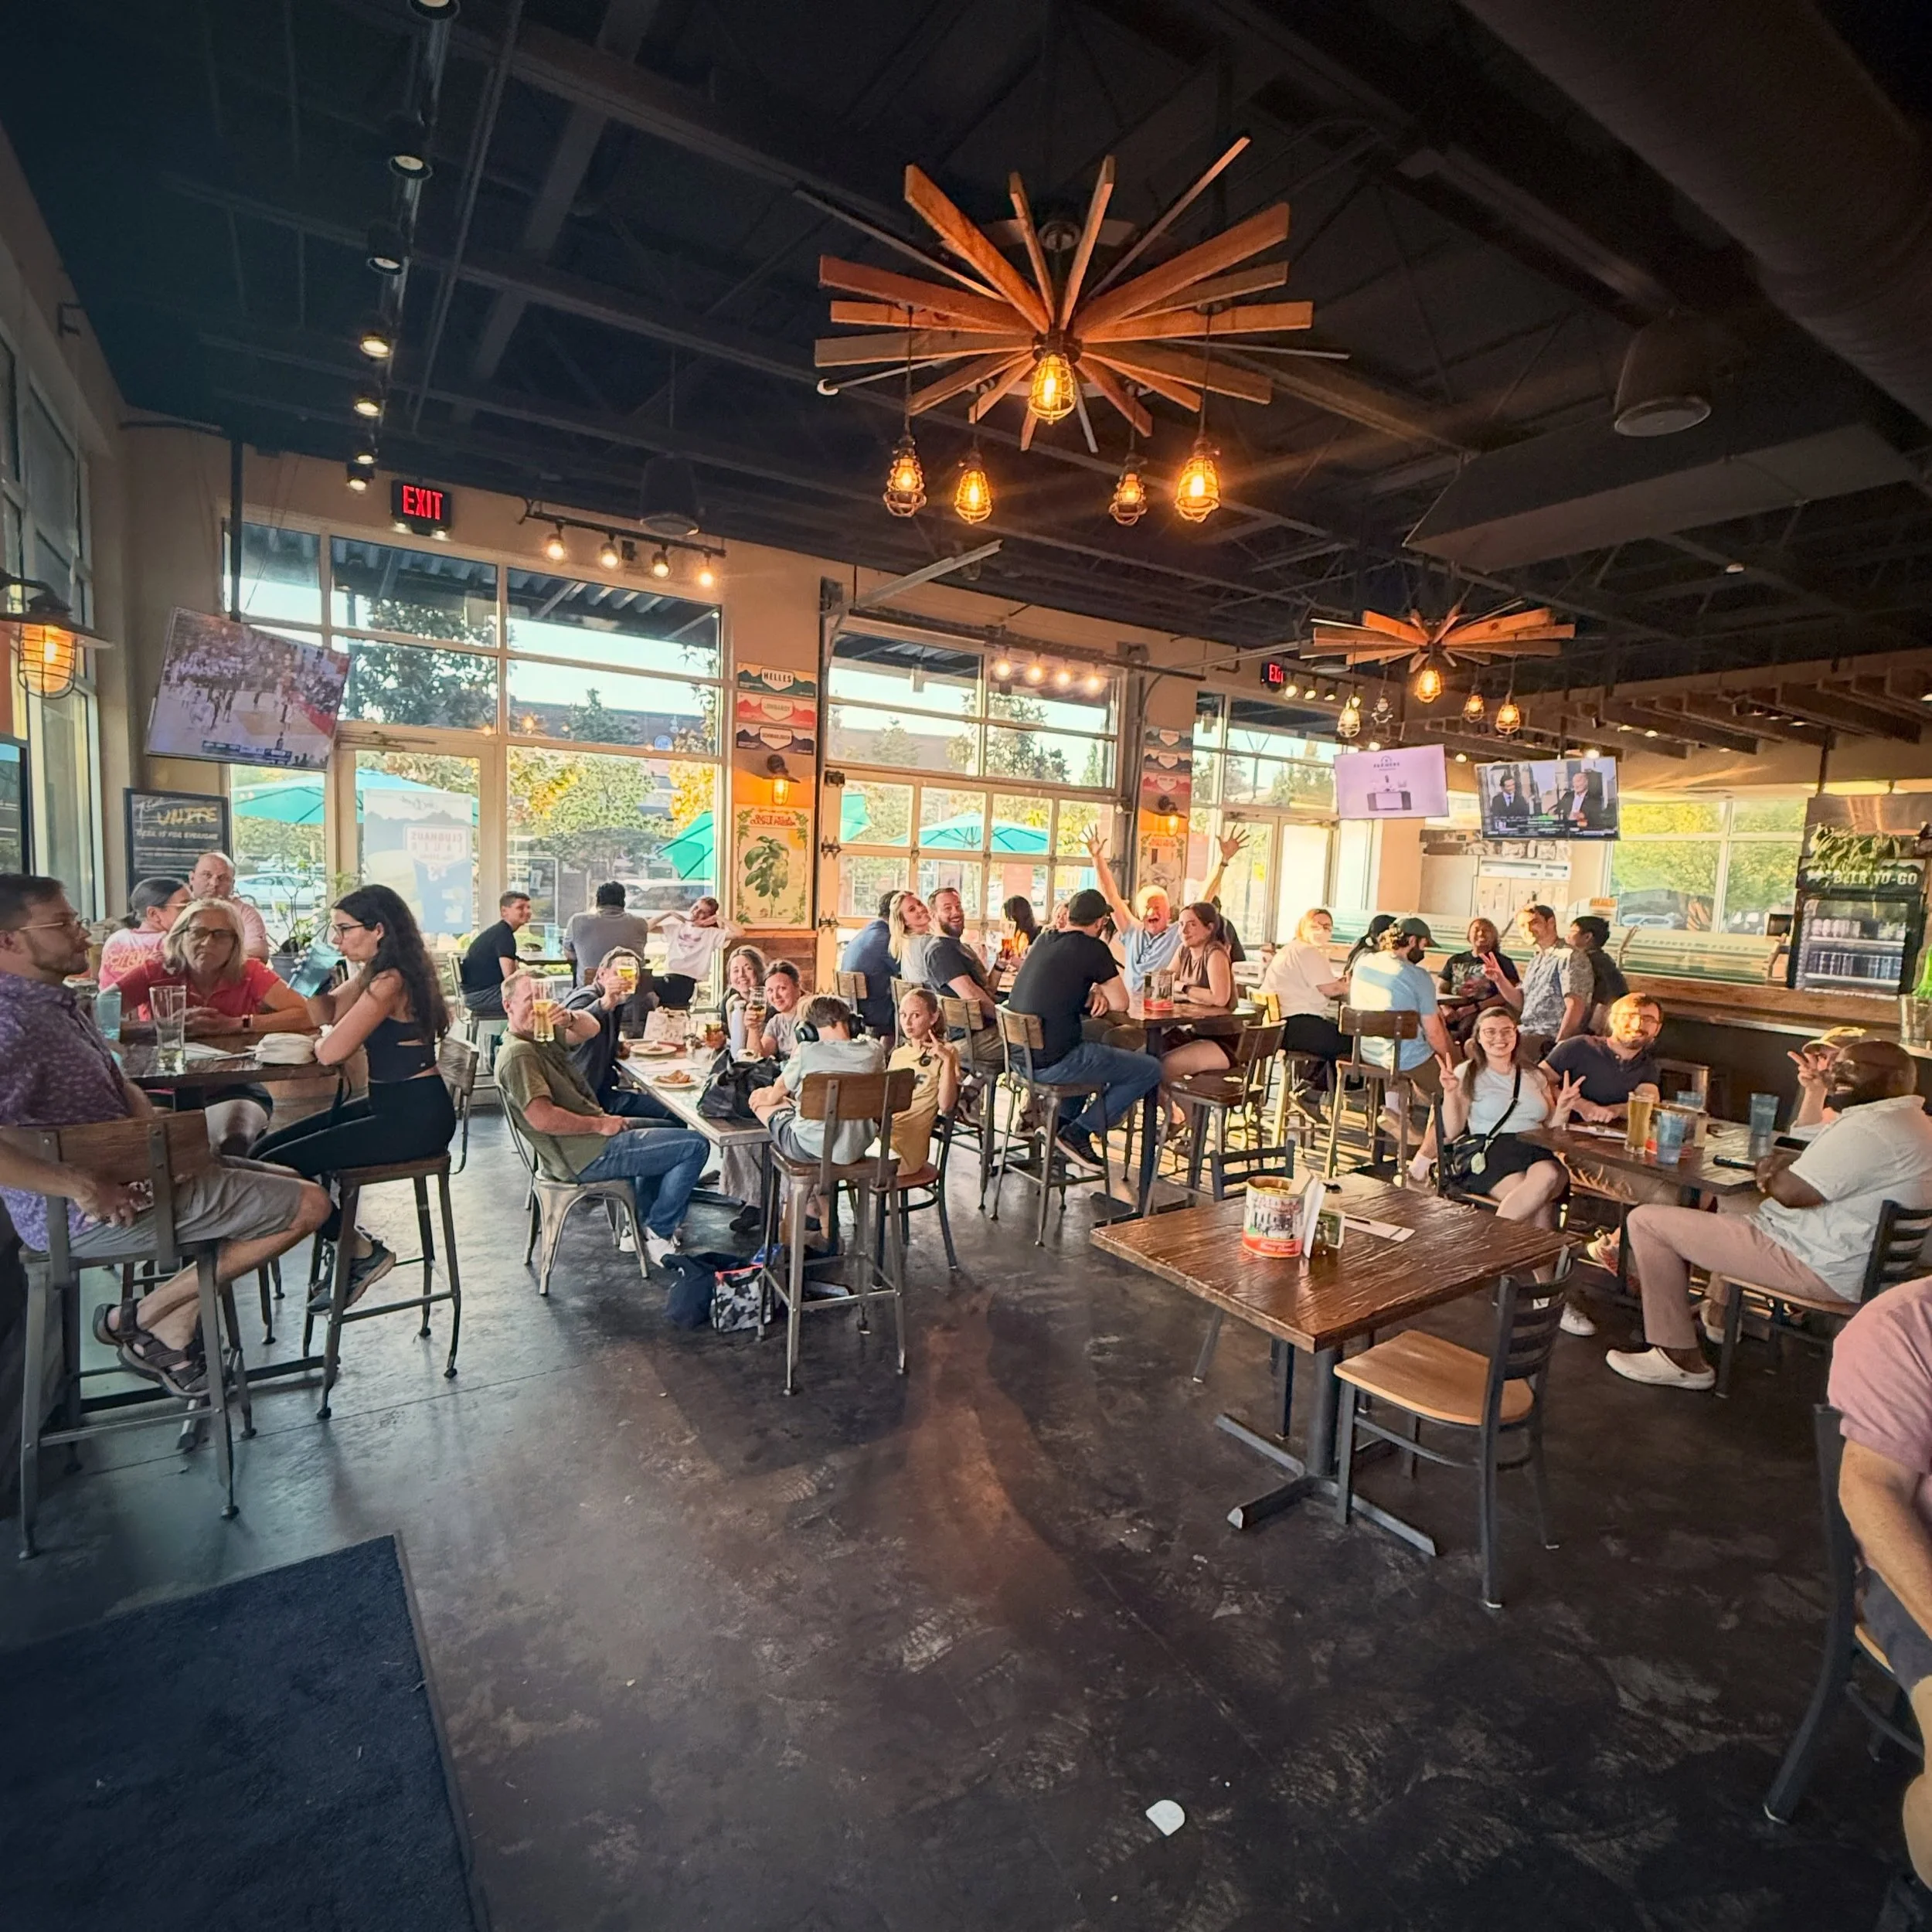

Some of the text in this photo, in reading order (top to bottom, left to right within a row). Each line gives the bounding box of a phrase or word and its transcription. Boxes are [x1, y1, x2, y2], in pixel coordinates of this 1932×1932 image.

[403, 485, 444, 520] EXIT
[763, 672, 792, 683] HELLES
[1872, 870, 1918, 886] TO-GO
